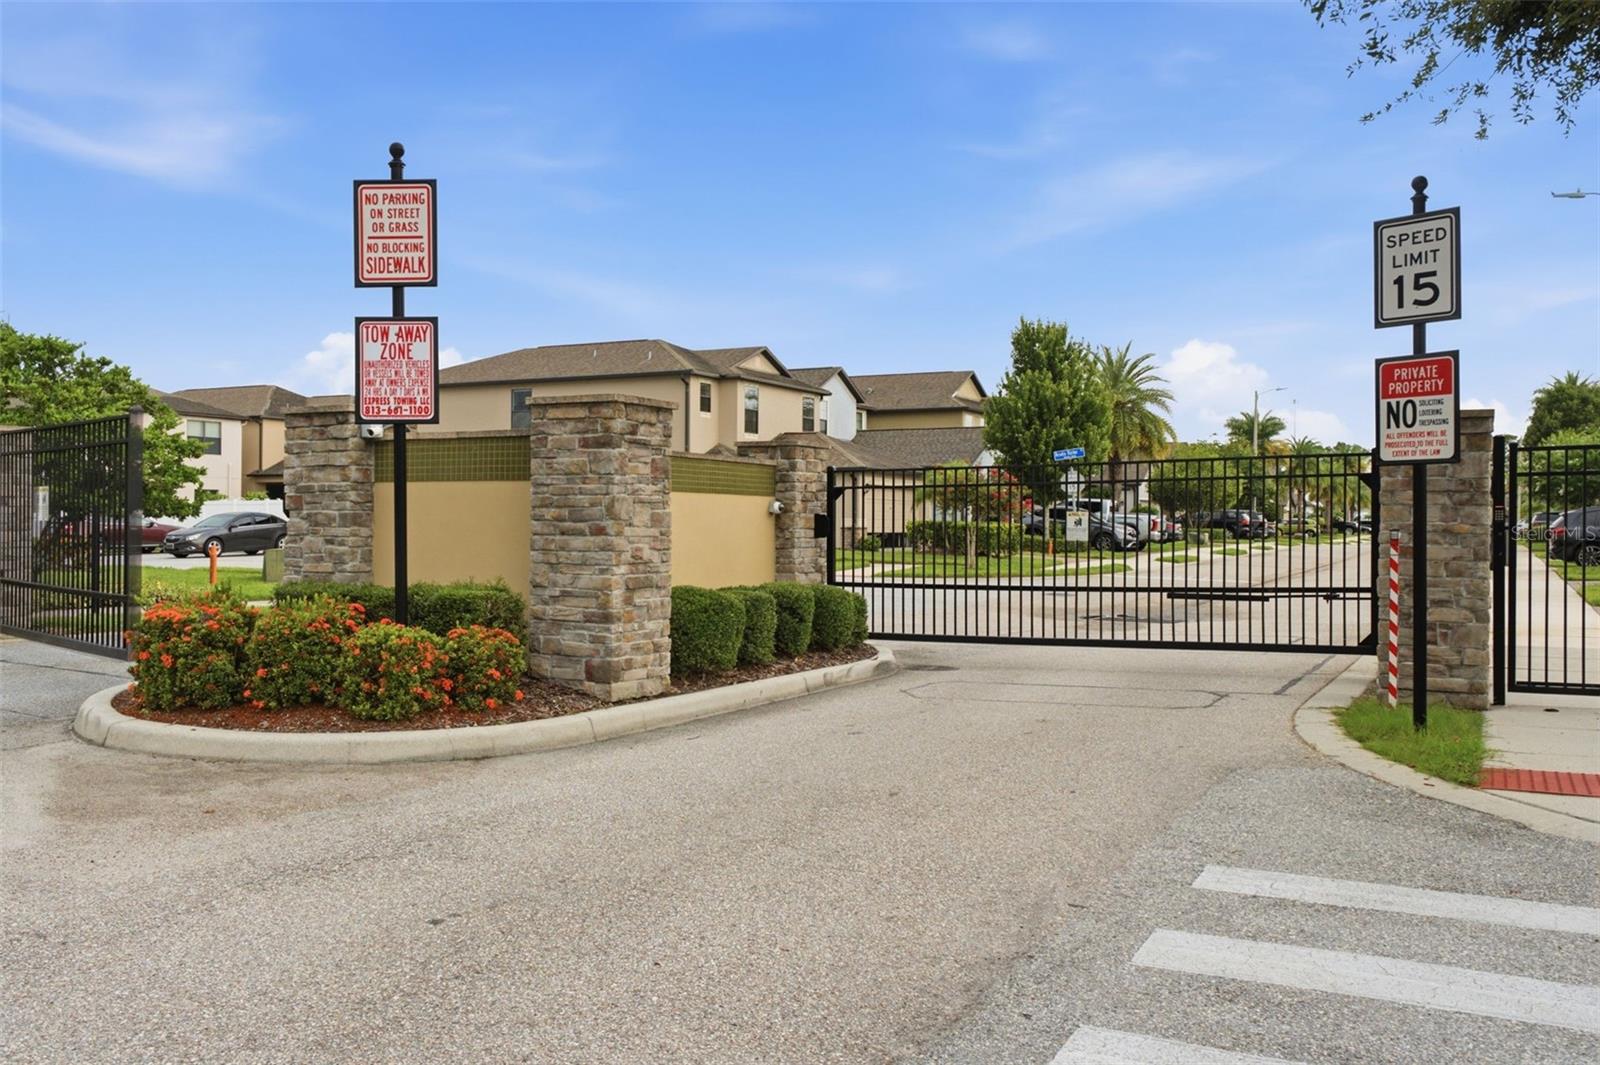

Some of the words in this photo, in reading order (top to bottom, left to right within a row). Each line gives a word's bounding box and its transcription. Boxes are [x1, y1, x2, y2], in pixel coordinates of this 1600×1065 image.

[365, 193, 378, 205] NO
[383, 193, 425, 205] PARKING
[370, 209, 383, 219] ON
[387, 208, 420, 218] STREET
[372, 222, 384, 232] OR
[389, 222, 419, 232] GRASS
[1386, 227, 1447, 248] SPEED
[367, 243, 378, 253] NO
[382, 243, 425, 253] BLOCKING
[366, 256, 425, 274] SIDEWALK
[1392, 249, 1440, 268] LIMIT
[1393, 270, 1440, 309] 15
[364, 326, 390, 342] TOW
[396, 326, 429, 342] AWAY
[380, 343, 413, 360] ZONE
[405, 360, 429, 368] VEHICLES
[1394, 365, 1438, 380] PRIVATE
[1388, 378, 1444, 395] PROPERTY
[364, 397, 390, 405] EXPRESS
[394, 397, 417, 405] TOWING
[420, 397, 430, 405] LLC
[1386, 399, 1417, 429] NO
[1419, 408, 1443, 416] LOITERING
[1419, 418, 1449, 426] TRESPASSING
[1396, 431, 1425, 439] OFFENDERS
